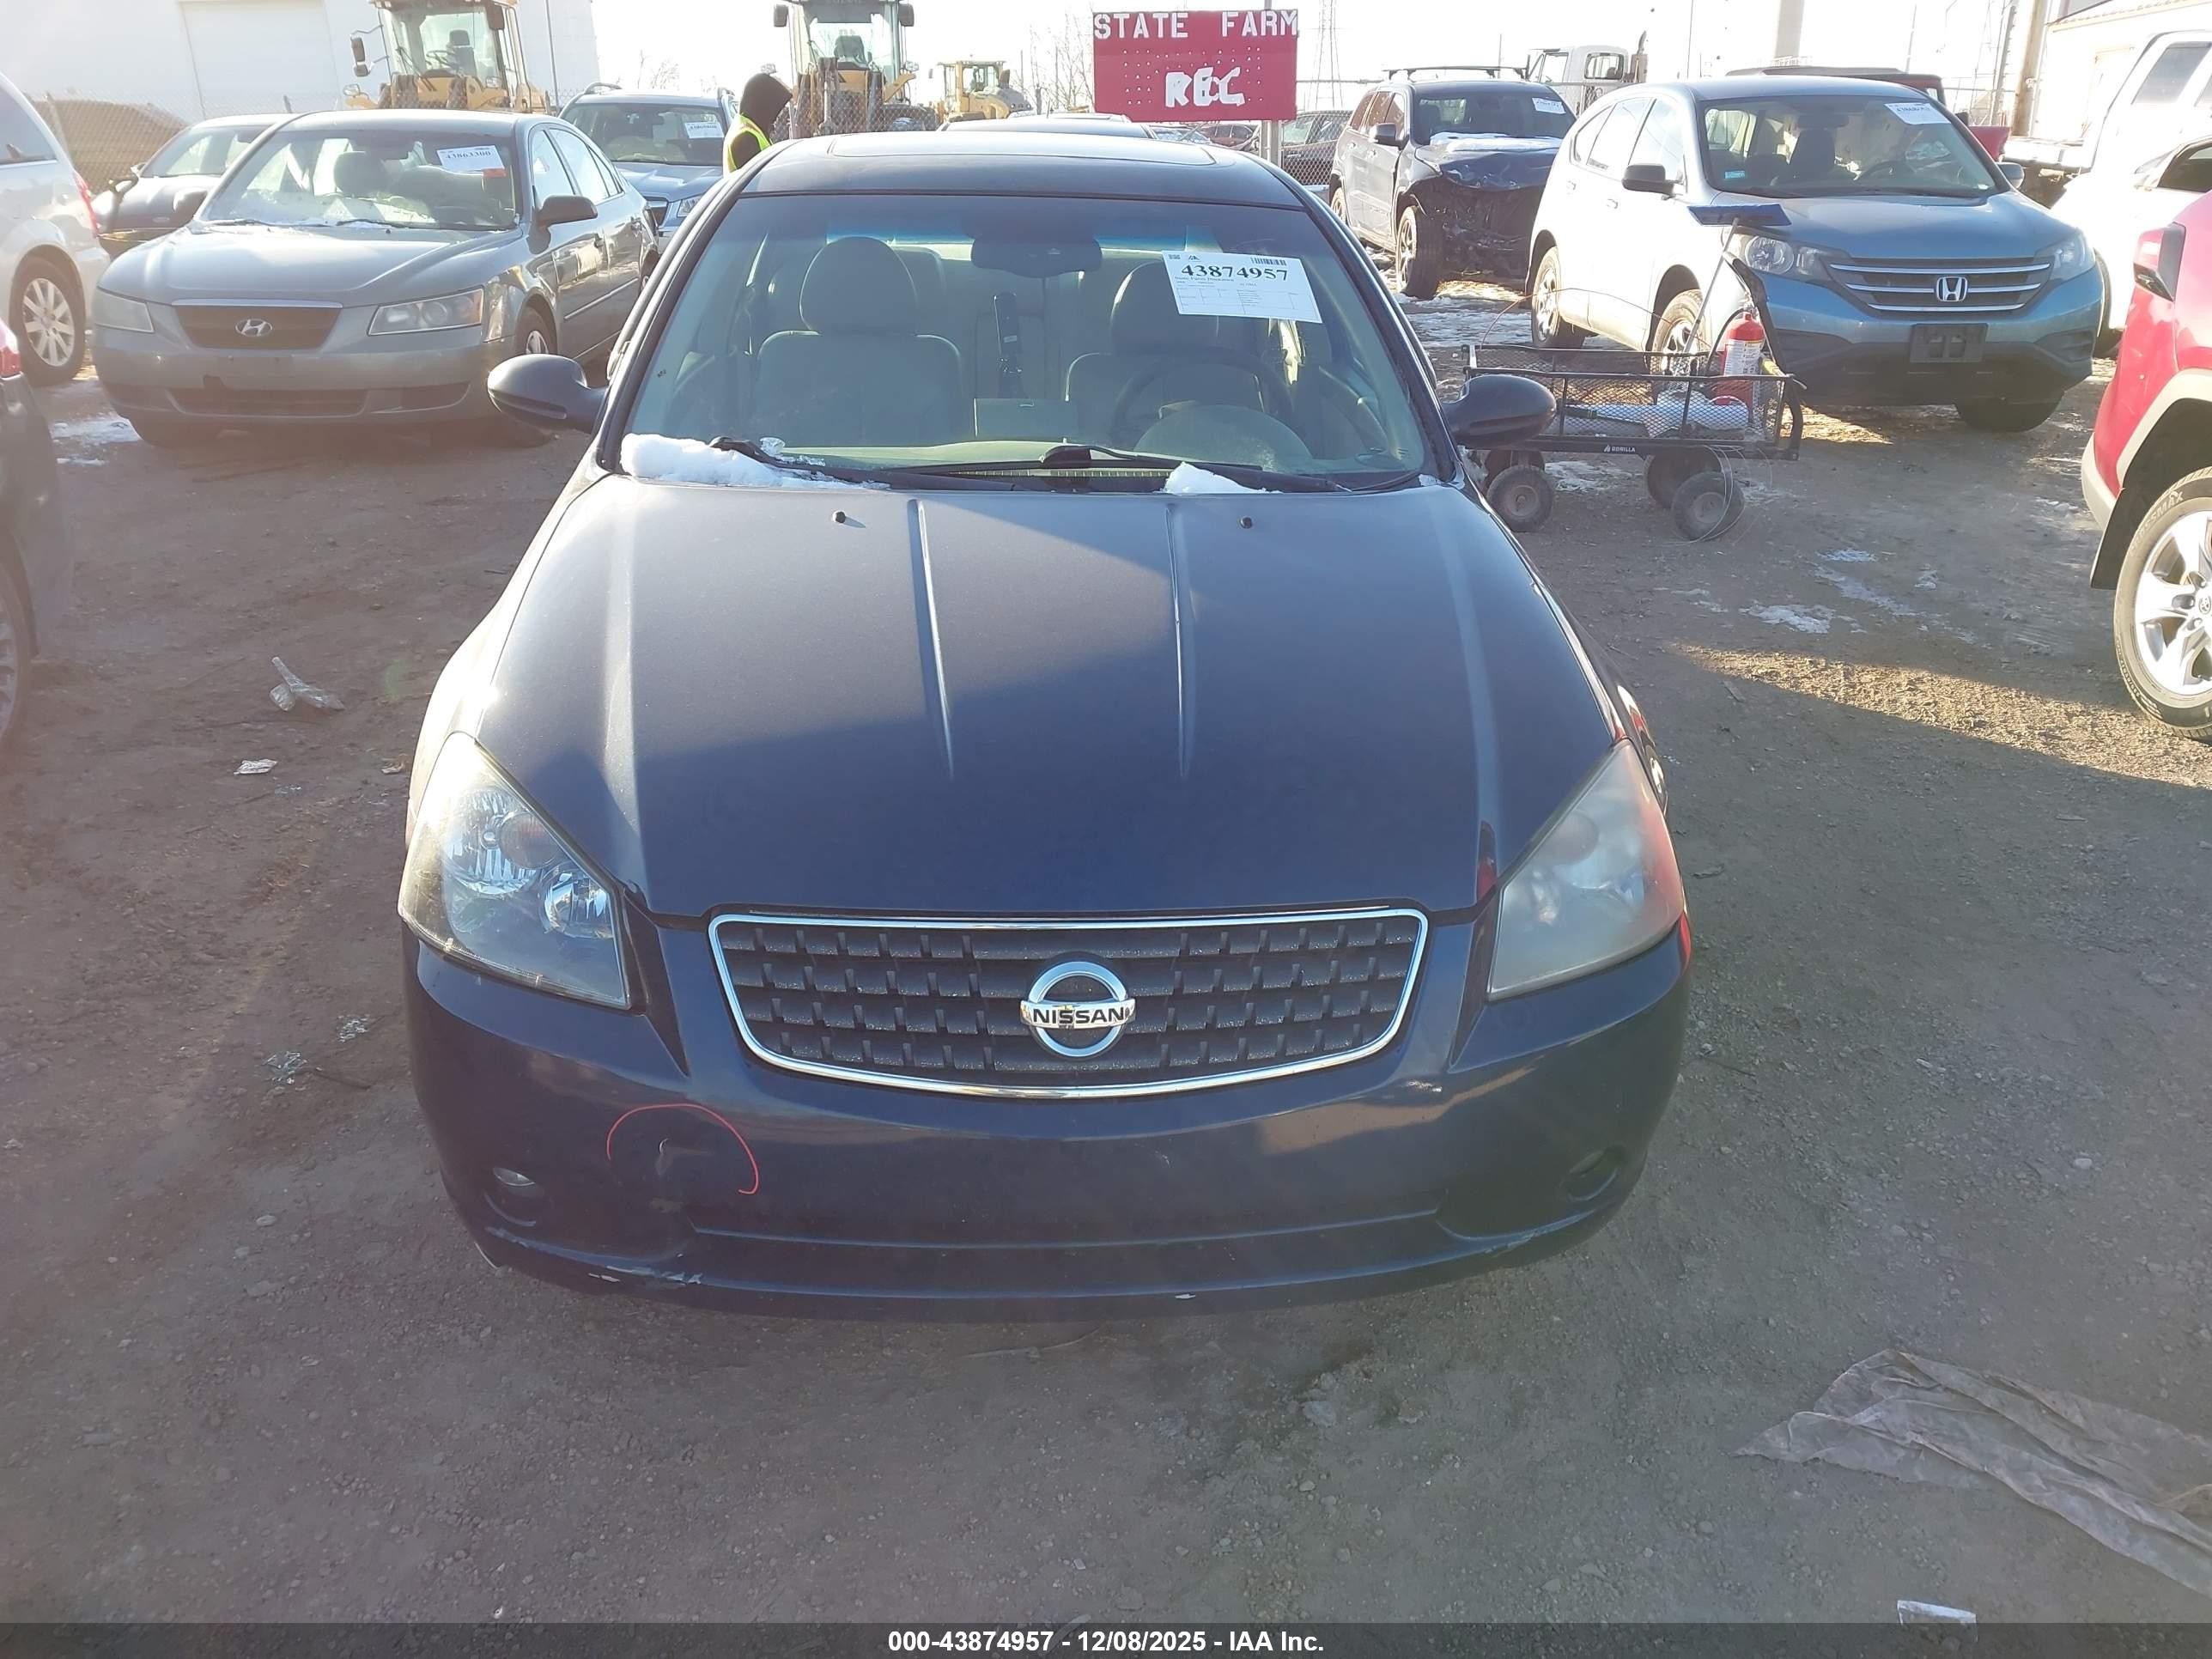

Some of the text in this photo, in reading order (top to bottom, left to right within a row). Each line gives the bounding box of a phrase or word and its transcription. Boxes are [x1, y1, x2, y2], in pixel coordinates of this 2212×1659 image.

[1093, 10, 1297, 40] STATE FARM
[1181, 264, 1288, 282] 43874957
[1032, 1006, 1125, 1024] NISSAN
